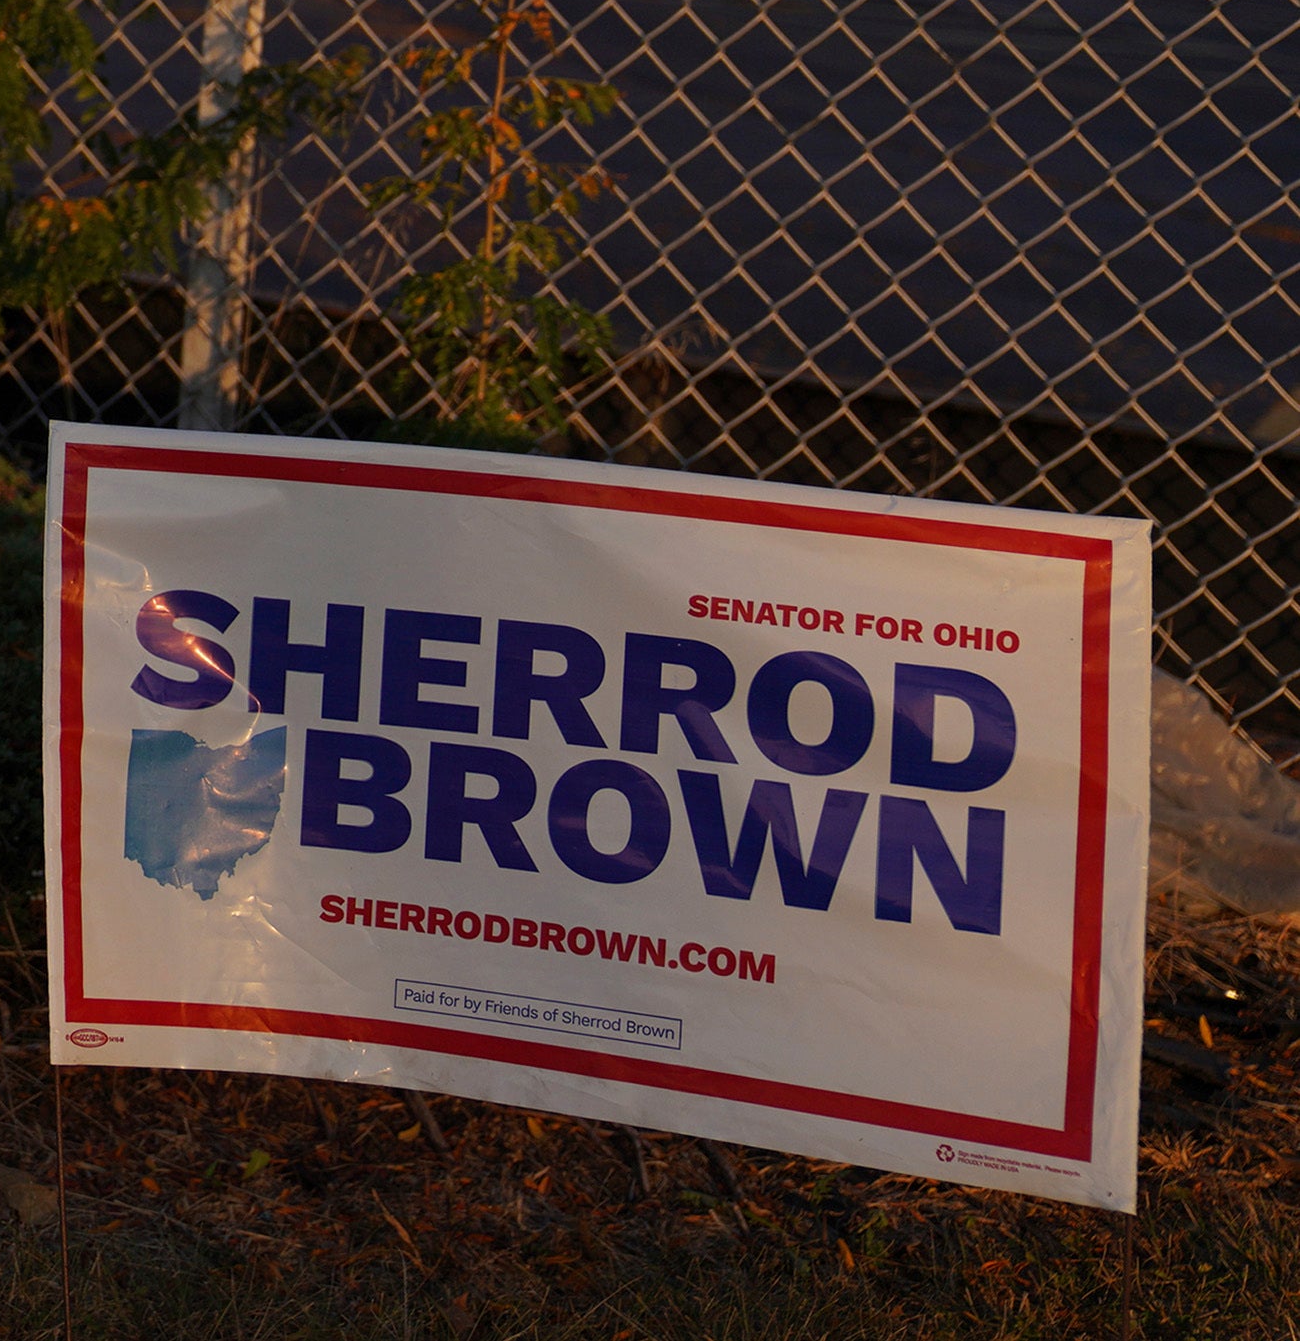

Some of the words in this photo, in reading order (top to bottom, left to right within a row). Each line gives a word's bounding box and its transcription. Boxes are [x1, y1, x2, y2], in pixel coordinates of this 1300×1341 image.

[687, 594, 845, 635] SENATOR
[854, 613, 923, 644] FOR
[933, 622, 1021, 654] OHIO
[129, 588, 1019, 794] SHERROD
[298, 728, 1007, 937] BROWN
[319, 894, 777, 983] SHERRODBROWN.COM
[404, 988, 434, 1004] Paid
[439, 992, 460, 1007] for
[463, 995, 482, 1014] by
[485, 999, 538, 1019] Friends
[543, 1008, 559, 1022] of
[562, 1011, 621, 1032] Sherrod
[626, 1020, 675, 1040] Brown
